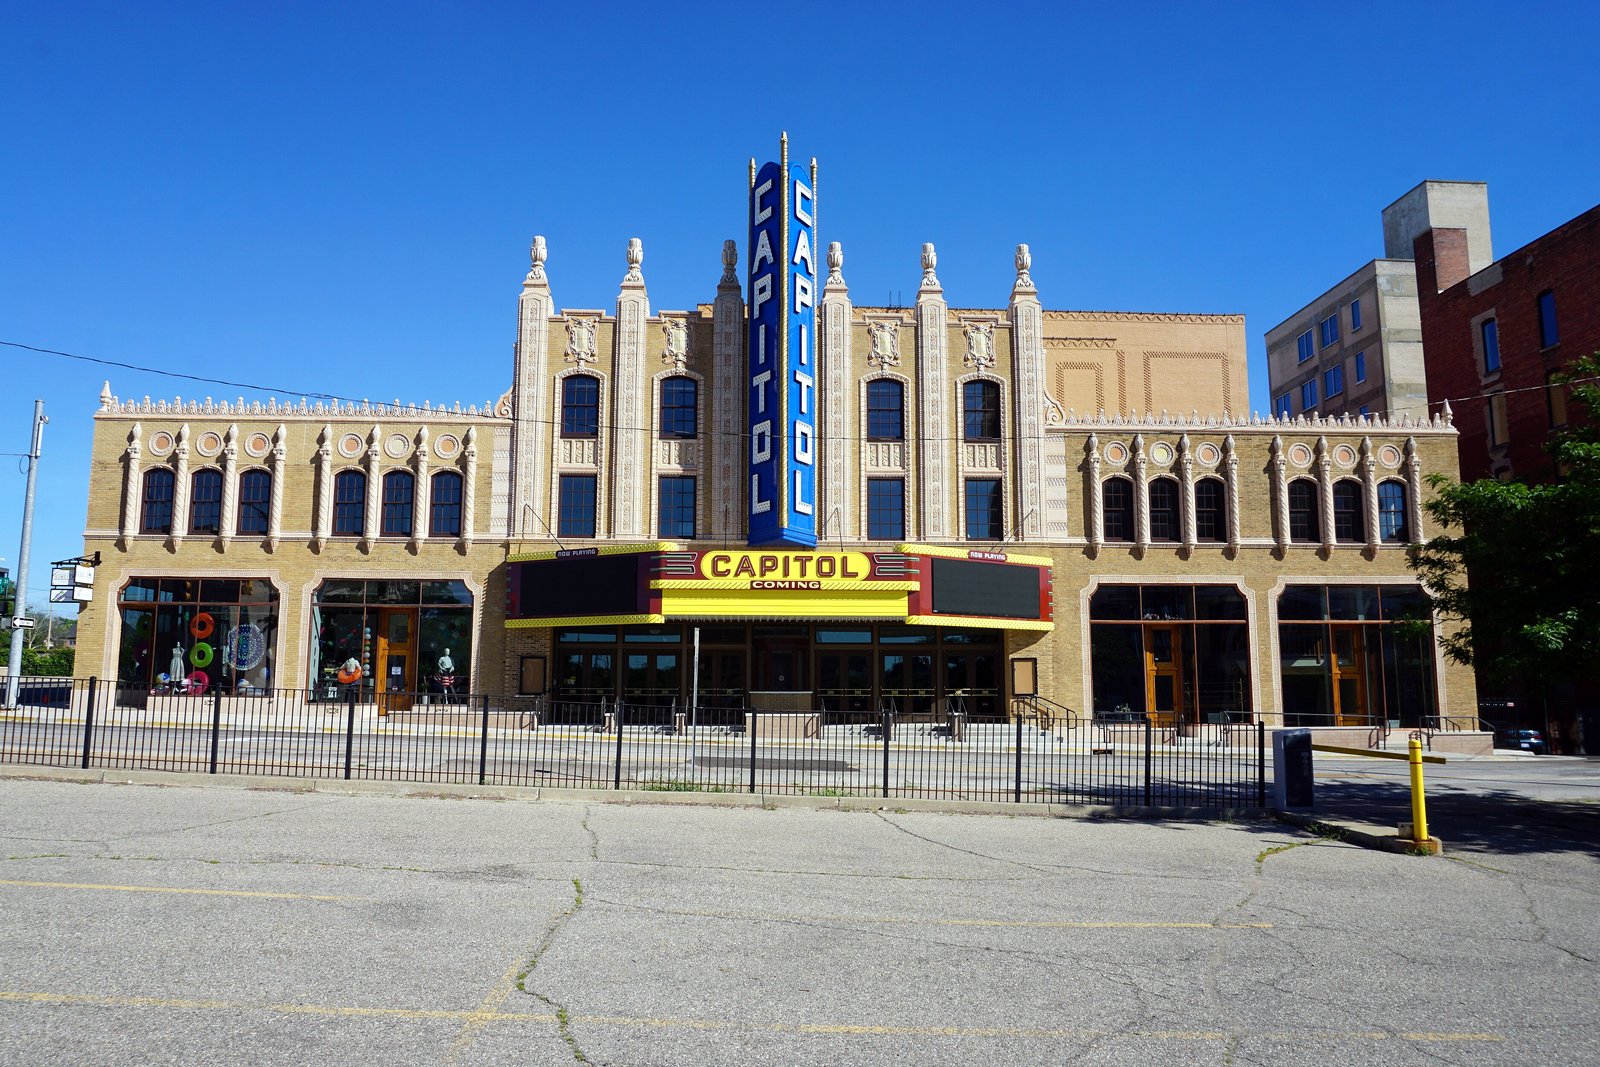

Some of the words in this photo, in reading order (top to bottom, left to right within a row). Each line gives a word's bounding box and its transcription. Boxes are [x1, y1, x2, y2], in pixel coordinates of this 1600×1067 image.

[752, 179, 774, 515] CAPITOL
[793, 179, 814, 515] CAPITOL
[572, 548, 596, 556] PLAYING
[984, 552, 1006, 560] PLAYING
[711, 555, 859, 578] CAPITOL
[752, 581, 820, 589] COMING
